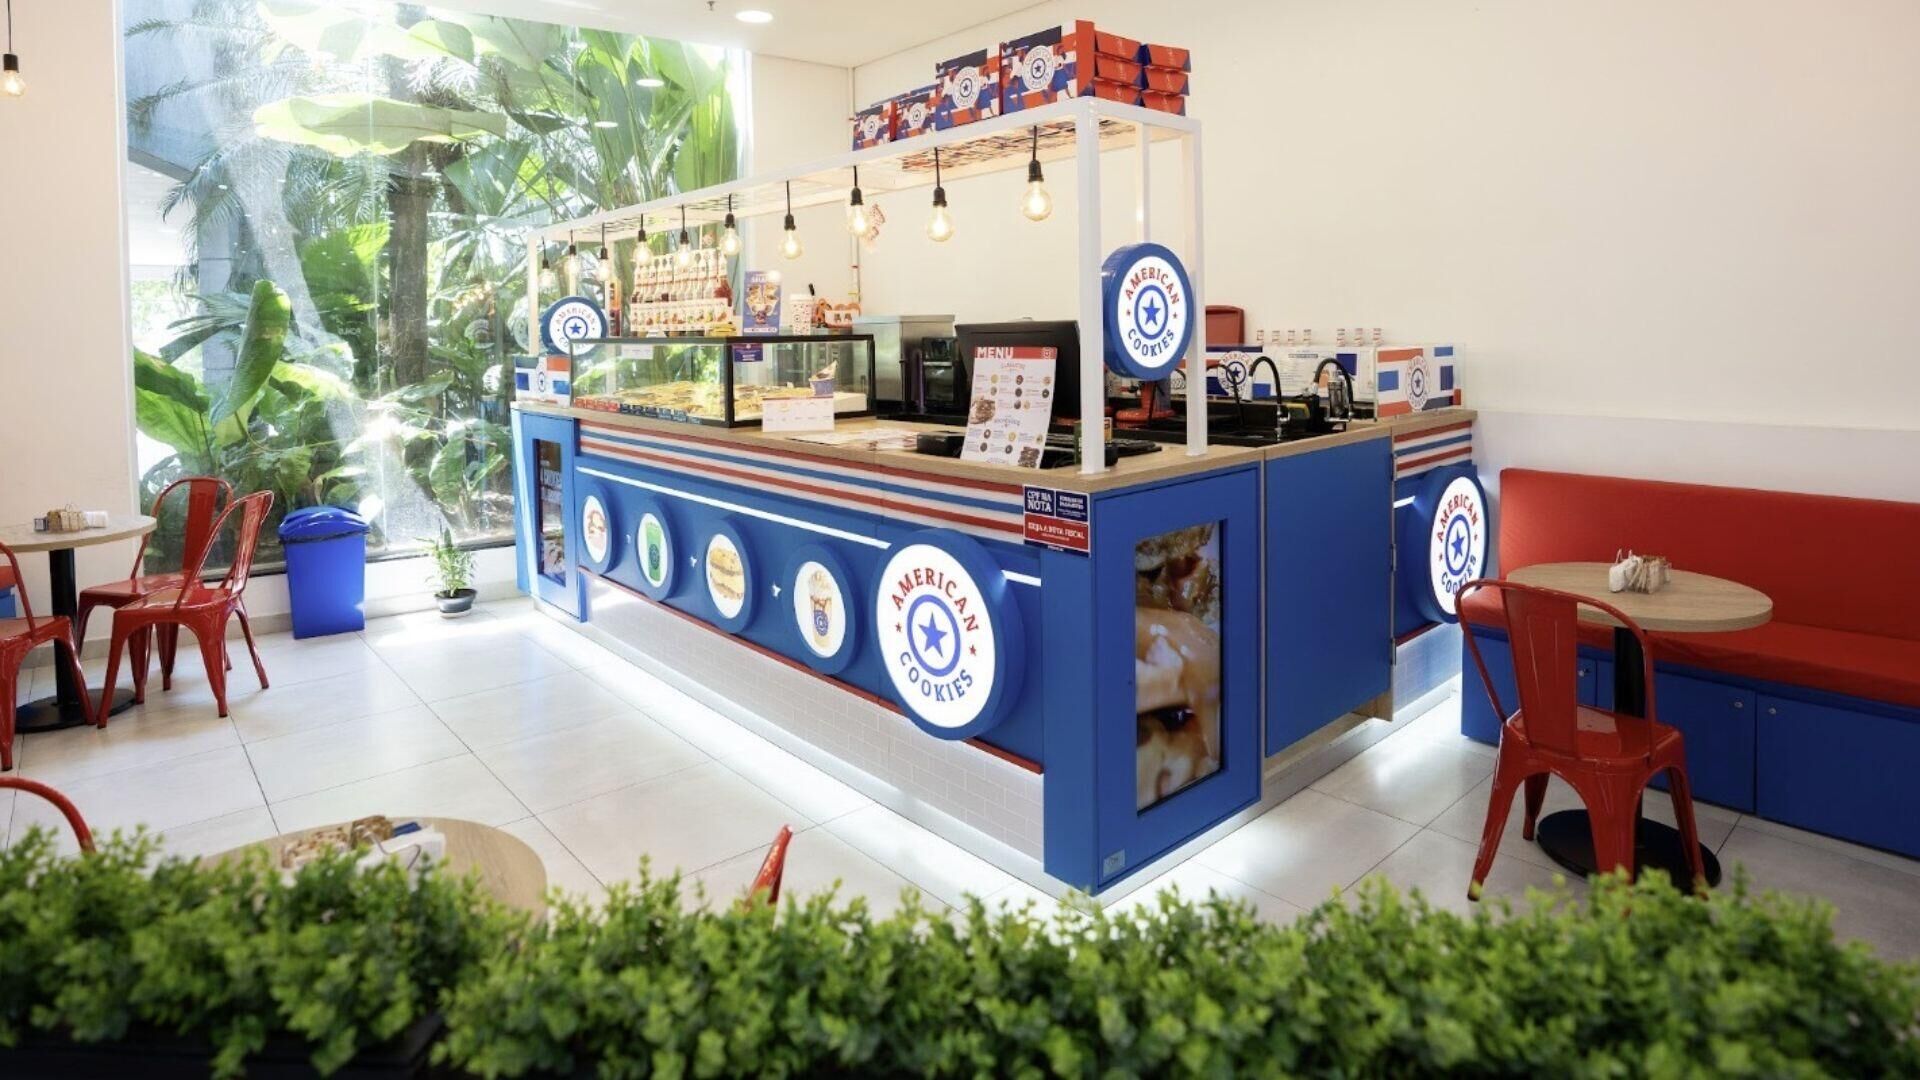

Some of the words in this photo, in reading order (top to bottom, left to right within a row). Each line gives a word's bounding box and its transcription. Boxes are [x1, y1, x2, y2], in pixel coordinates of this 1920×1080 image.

[1125, 267, 1180, 305] AMERICAN
[977, 347, 1014, 359] MENU
[1128, 328, 1174, 357] COOKIES
[1027, 499, 1053, 513] NOTA
[1437, 494, 1479, 543] AMERICAN
[891, 567, 979, 633] AMERICAN
[900, 651, 973, 702] COOKIES
